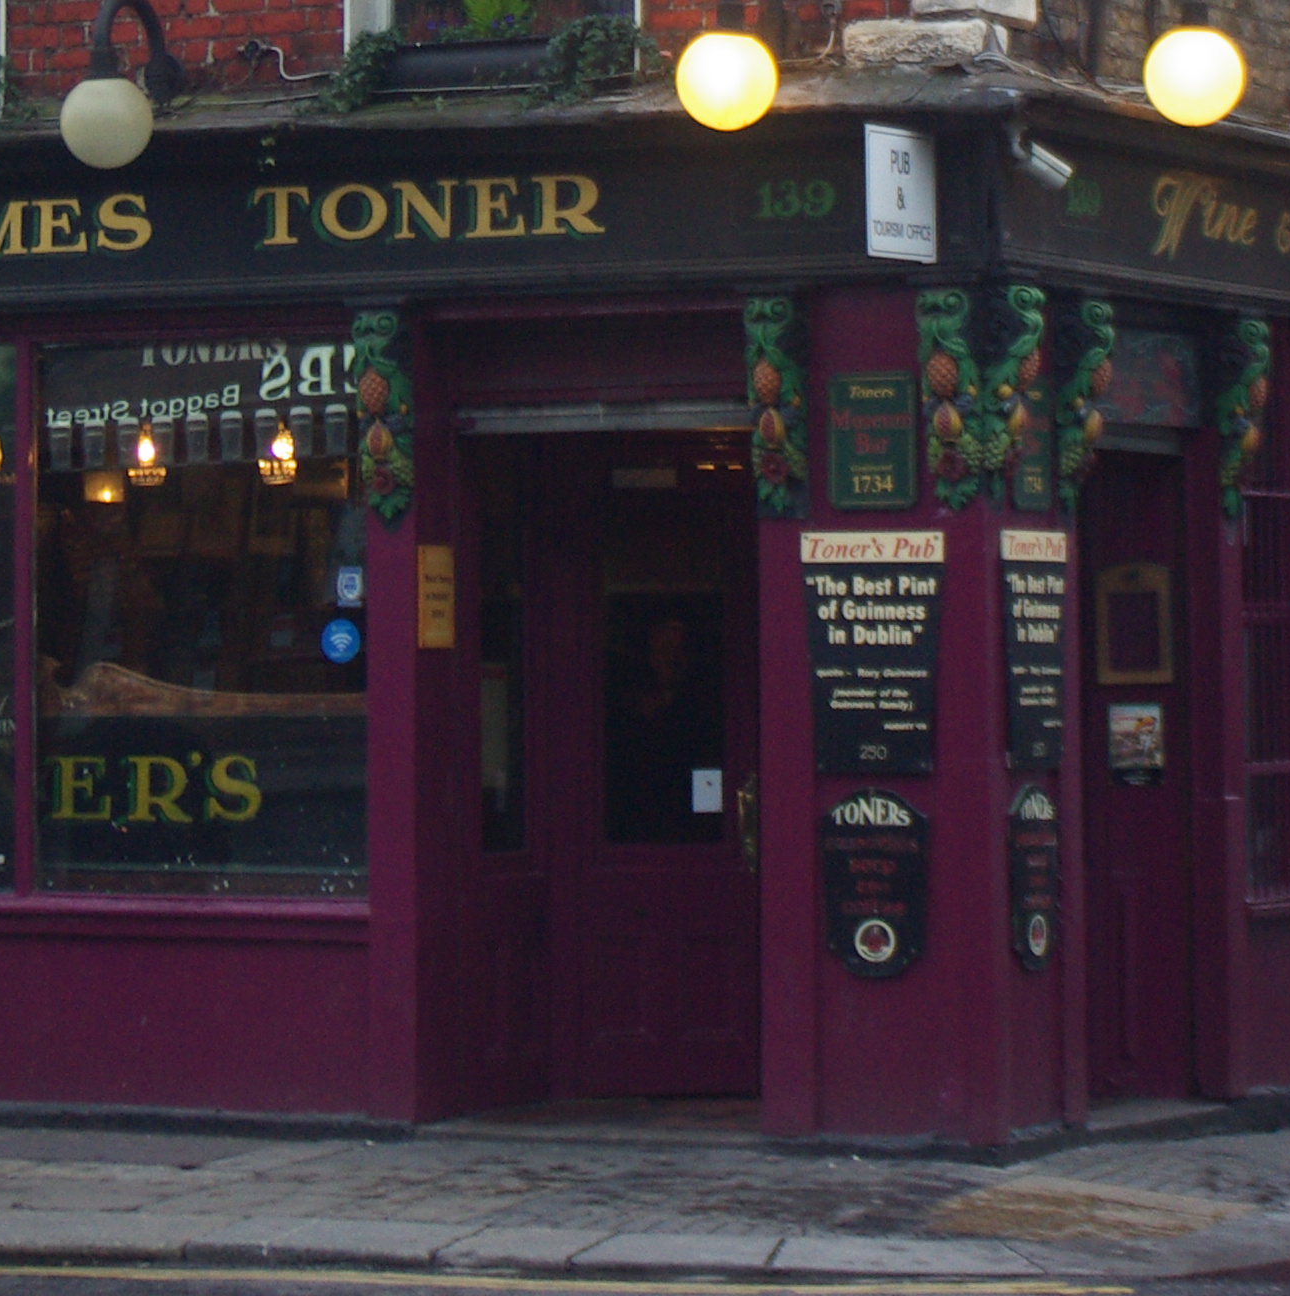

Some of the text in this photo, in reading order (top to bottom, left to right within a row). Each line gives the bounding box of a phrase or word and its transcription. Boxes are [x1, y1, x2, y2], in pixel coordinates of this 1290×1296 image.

[890, 149, 910, 176] PUB
[755, 178, 837, 220] 139
[896, 187, 907, 212] &
[254, 174, 606, 247] TONER
[1152, 175, 1256, 260] Wine
[872, 220, 932, 242] TOURISM OFFICE
[808, 537, 936, 559] Toner's Pub
[852, 576, 893, 596] Best
[898, 575, 937, 595] Pint
[817, 599, 926, 621] of Guinness
[828, 625, 847, 645] in
[859, 745, 887, 760] 250
